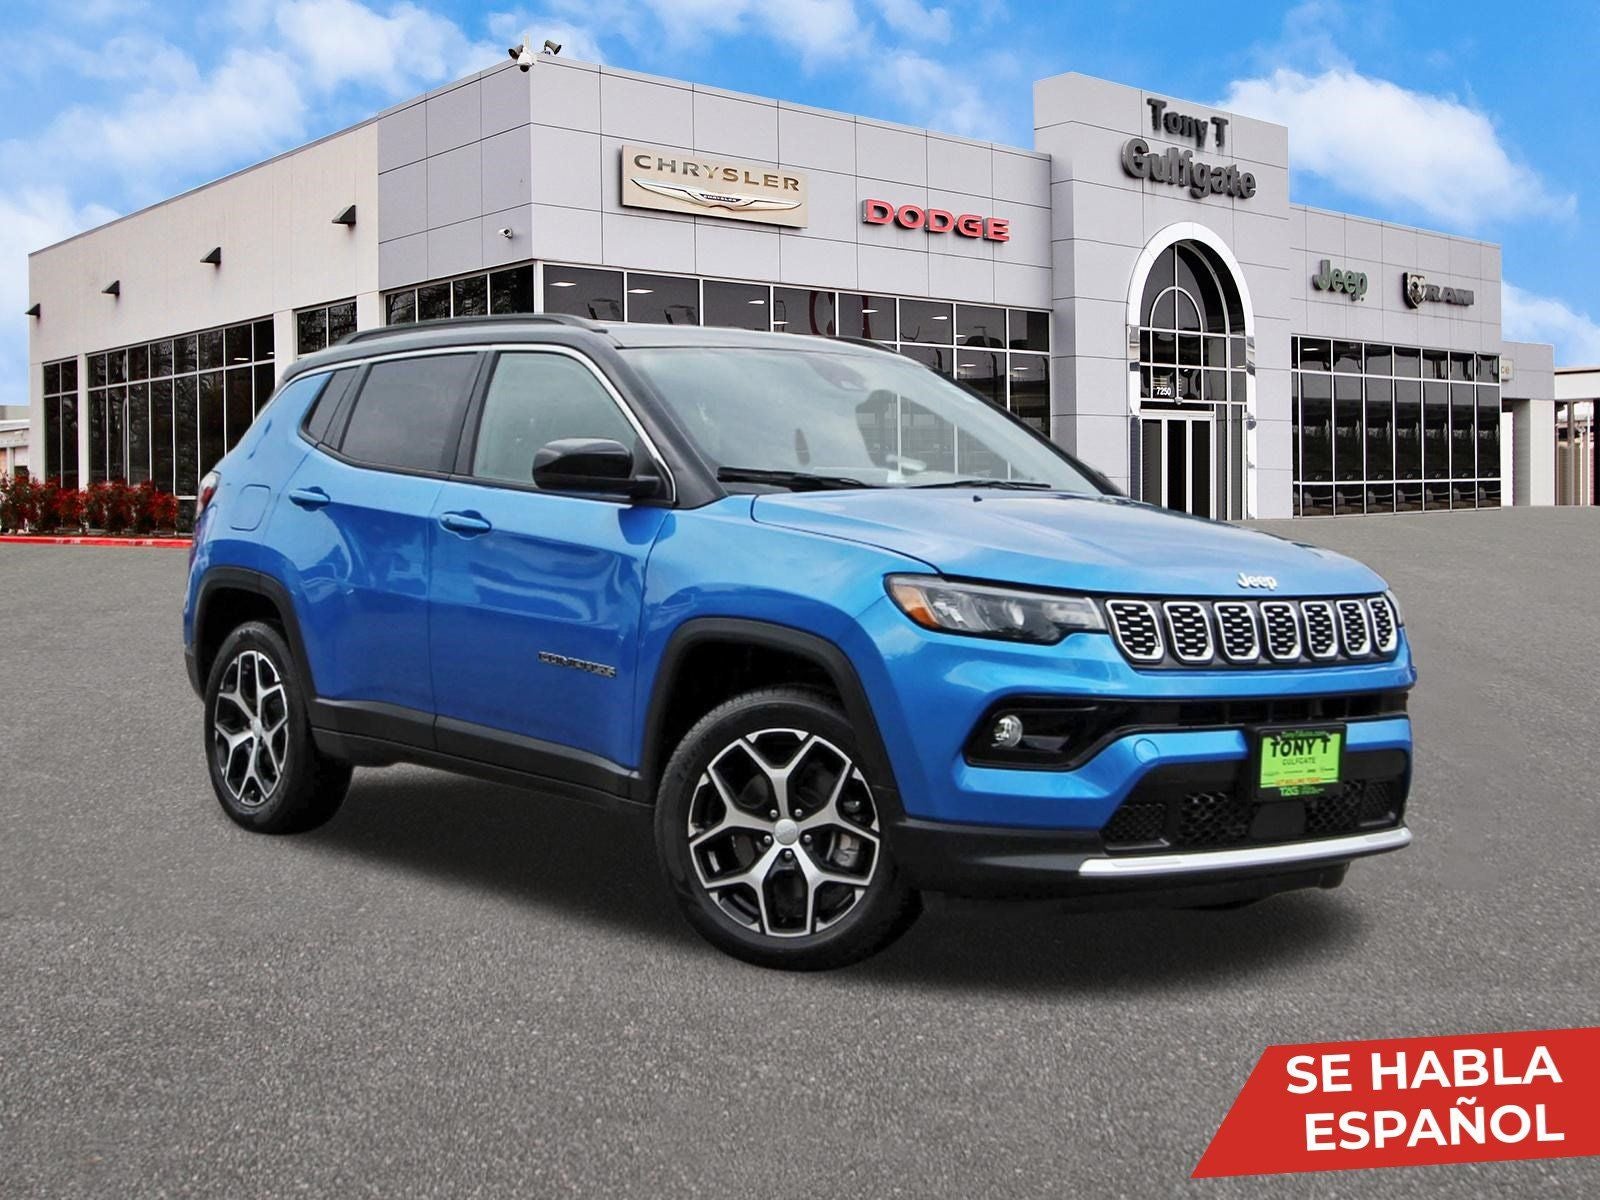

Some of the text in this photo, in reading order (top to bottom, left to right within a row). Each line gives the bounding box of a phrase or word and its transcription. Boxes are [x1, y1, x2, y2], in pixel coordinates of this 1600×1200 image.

[1146, 98, 1229, 147] Tony T
[633, 154, 800, 192] CHRYSLER
[1121, 138, 1257, 199] Gulfgate
[862, 199, 1010, 242] DODGE
[1312, 259, 1368, 301] Jeep
[1424, 284, 1475, 306] RAM
[1156, 386, 1172, 396] 7250
[1237, 572, 1278, 591] Jeep
[1270, 737, 1331, 758] TONY T
